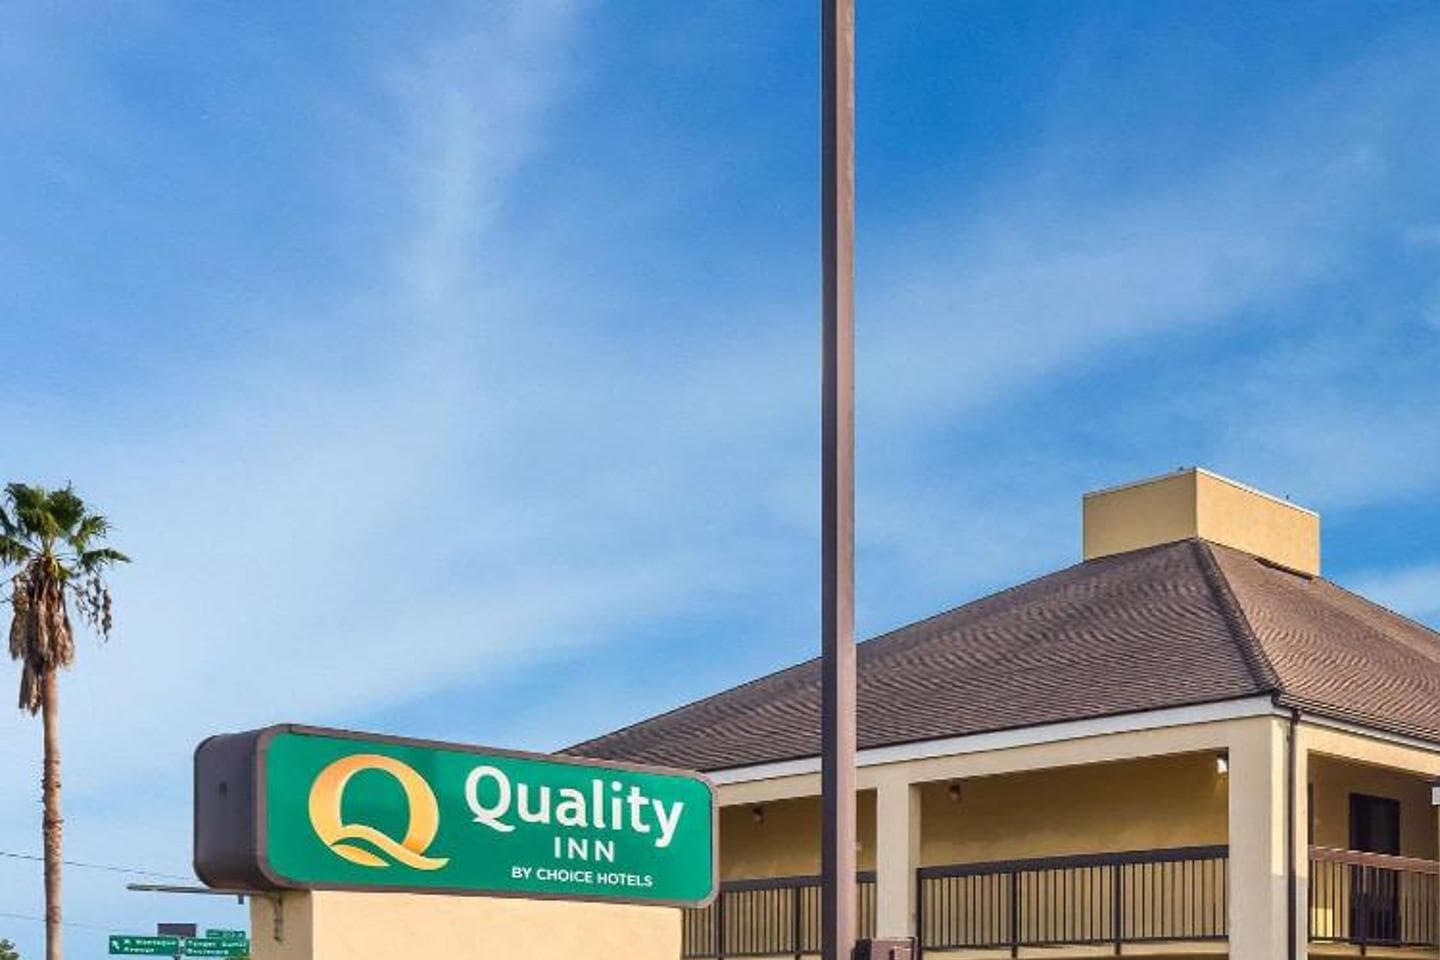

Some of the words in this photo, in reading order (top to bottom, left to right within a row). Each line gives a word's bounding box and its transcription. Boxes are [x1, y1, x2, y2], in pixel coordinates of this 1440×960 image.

[308, 754, 450, 870] Q
[465, 765, 684, 848] Quality
[554, 836, 614, 862] INN
[511, 866, 532, 879] BY
[536, 868, 593, 884] CHOICE
[597, 872, 653, 887] HOTELS
